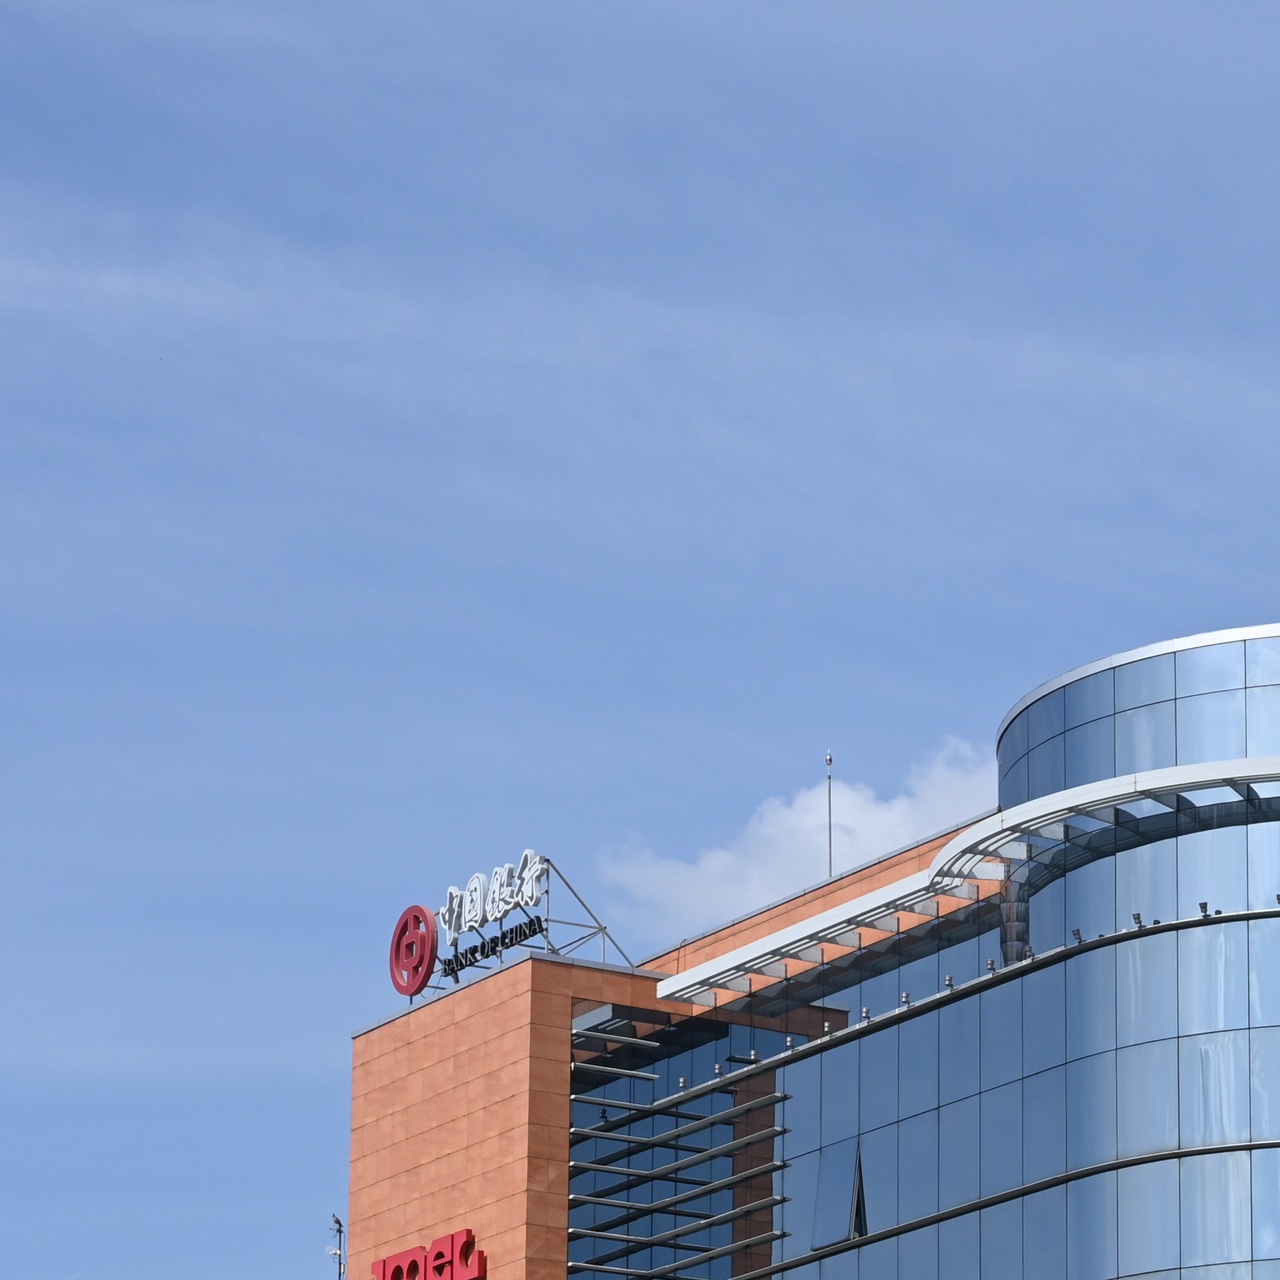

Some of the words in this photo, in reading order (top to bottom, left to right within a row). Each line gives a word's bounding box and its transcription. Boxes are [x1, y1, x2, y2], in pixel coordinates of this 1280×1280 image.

[442, 945, 478, 977] BANK
[479, 935, 501, 959] OF
[499, 915, 546, 952] CHINA
